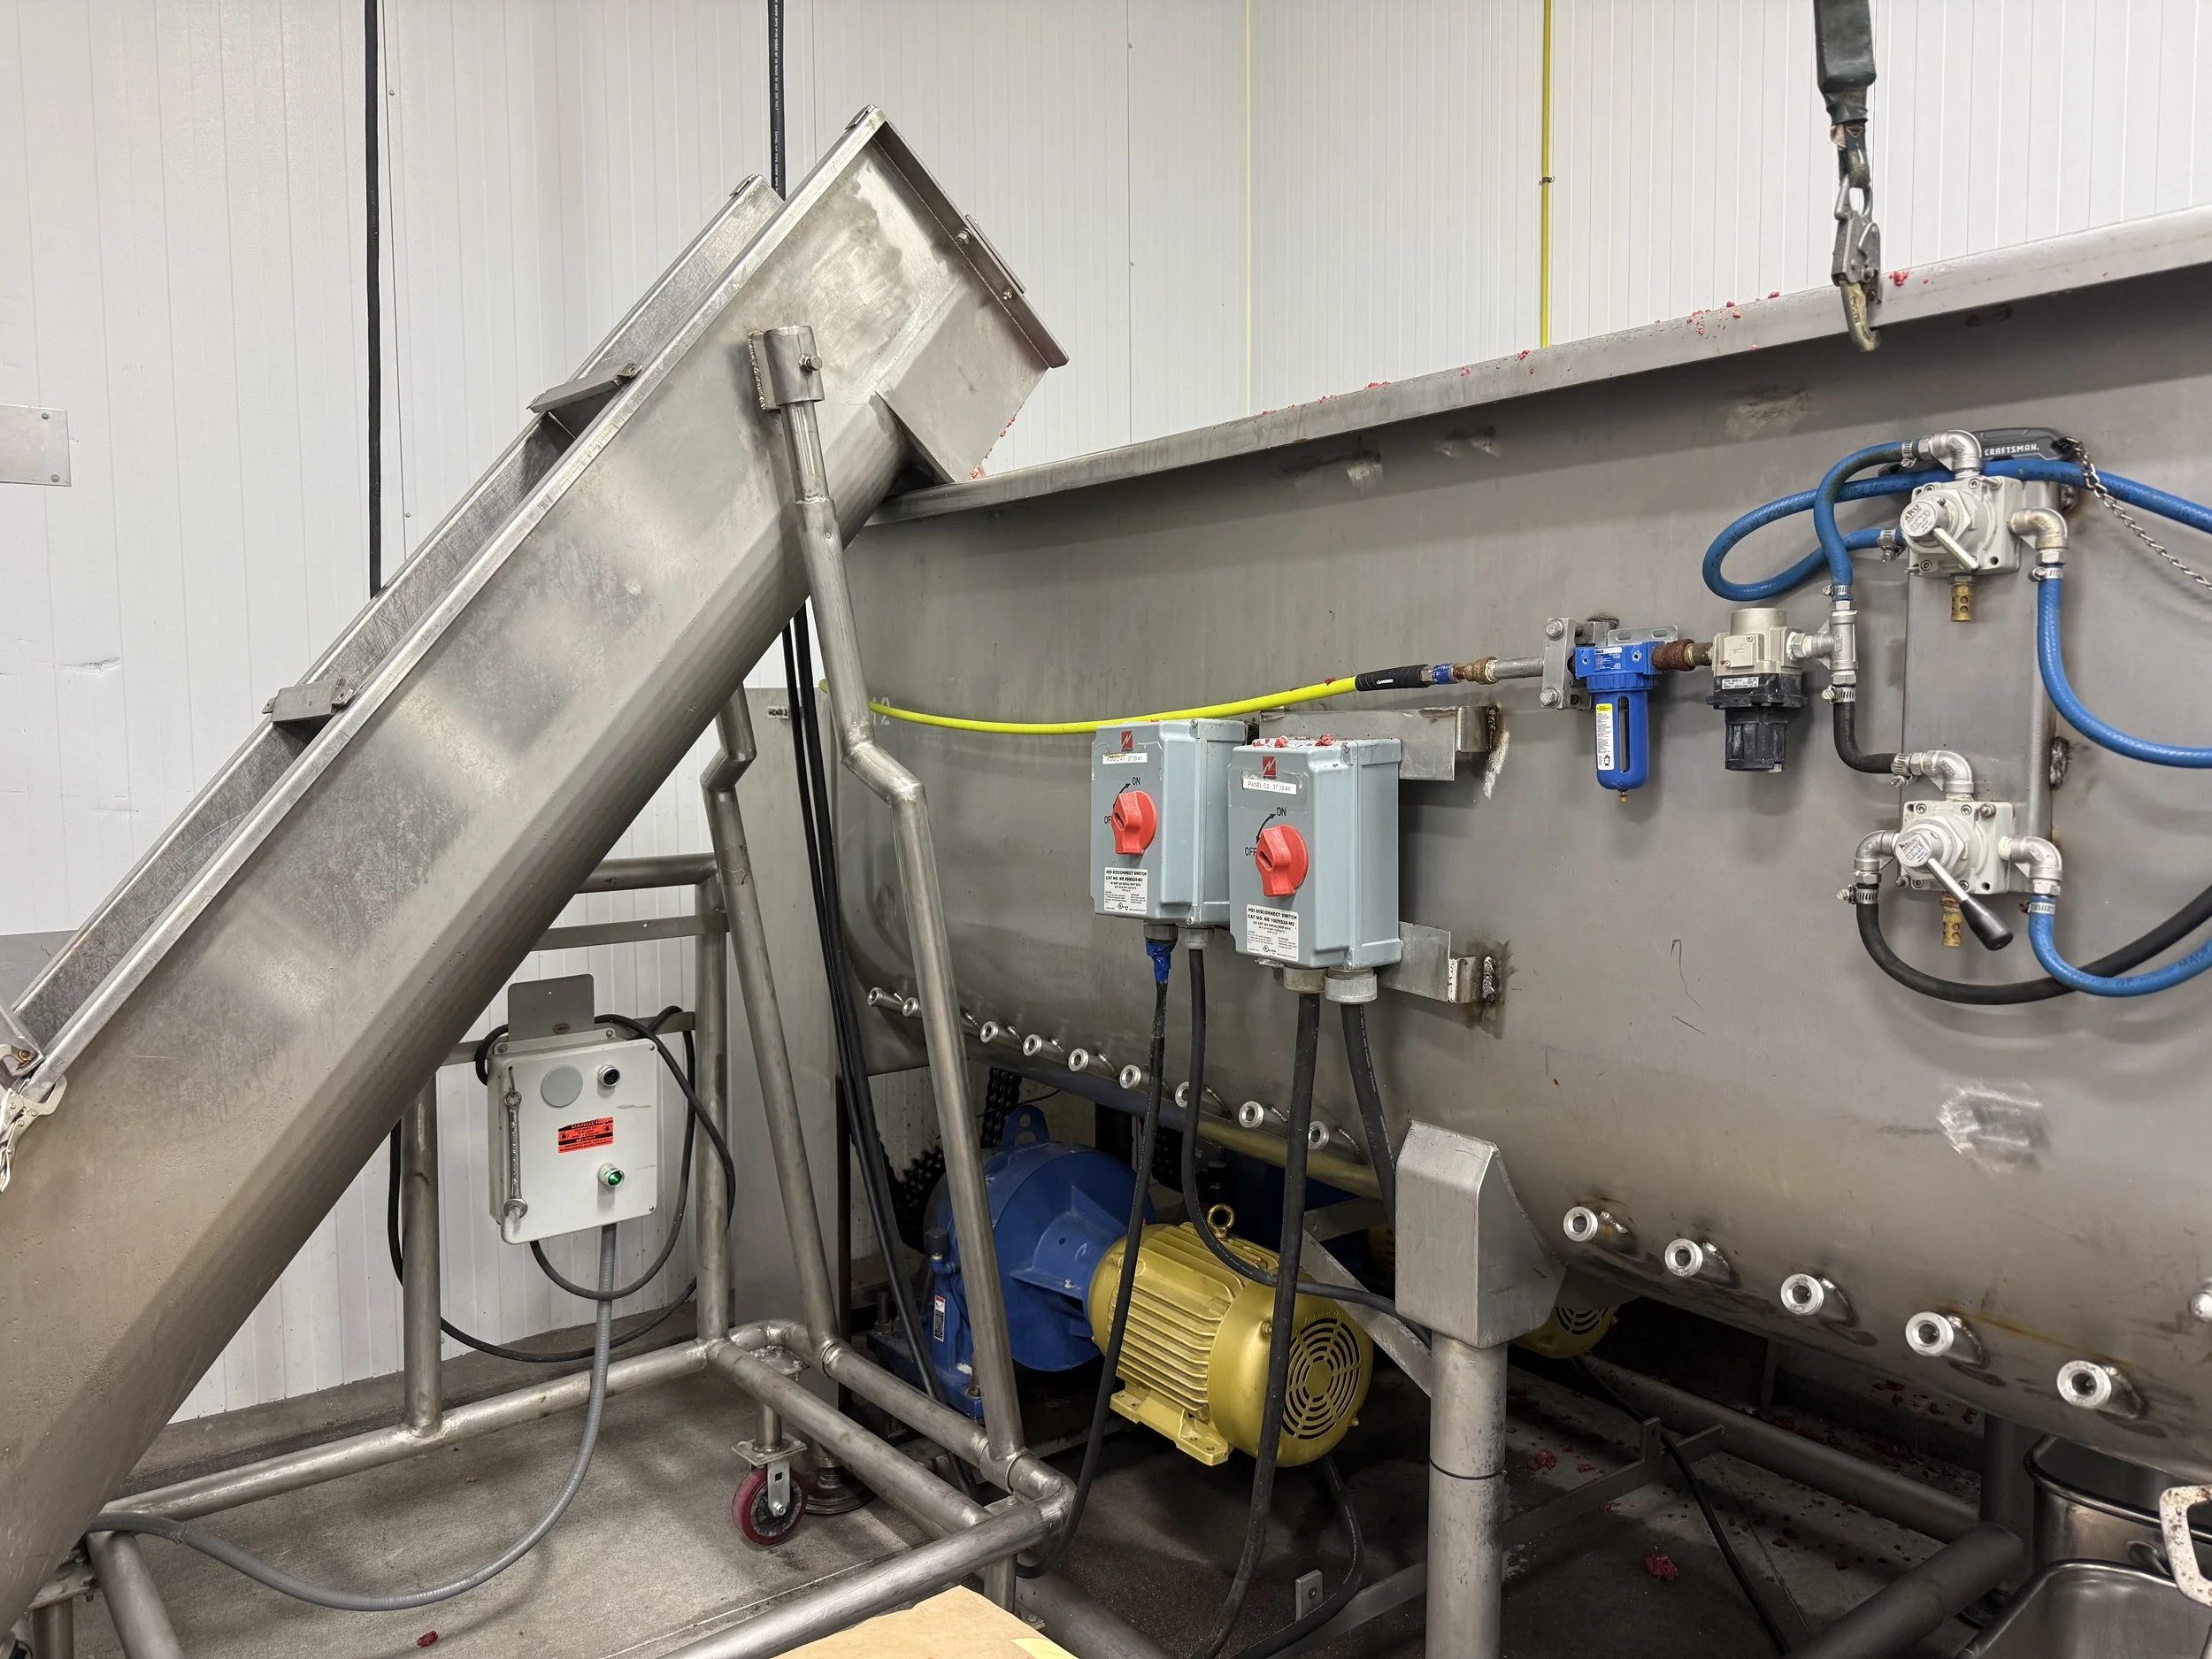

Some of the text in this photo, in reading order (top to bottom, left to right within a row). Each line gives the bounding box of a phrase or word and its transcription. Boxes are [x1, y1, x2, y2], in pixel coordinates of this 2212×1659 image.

[1905, 504, 1919, 521] ARO
[1132, 777, 1141, 786] ON
[1277, 807, 1286, 817] ON
[1245, 847, 1257, 856] OFF
